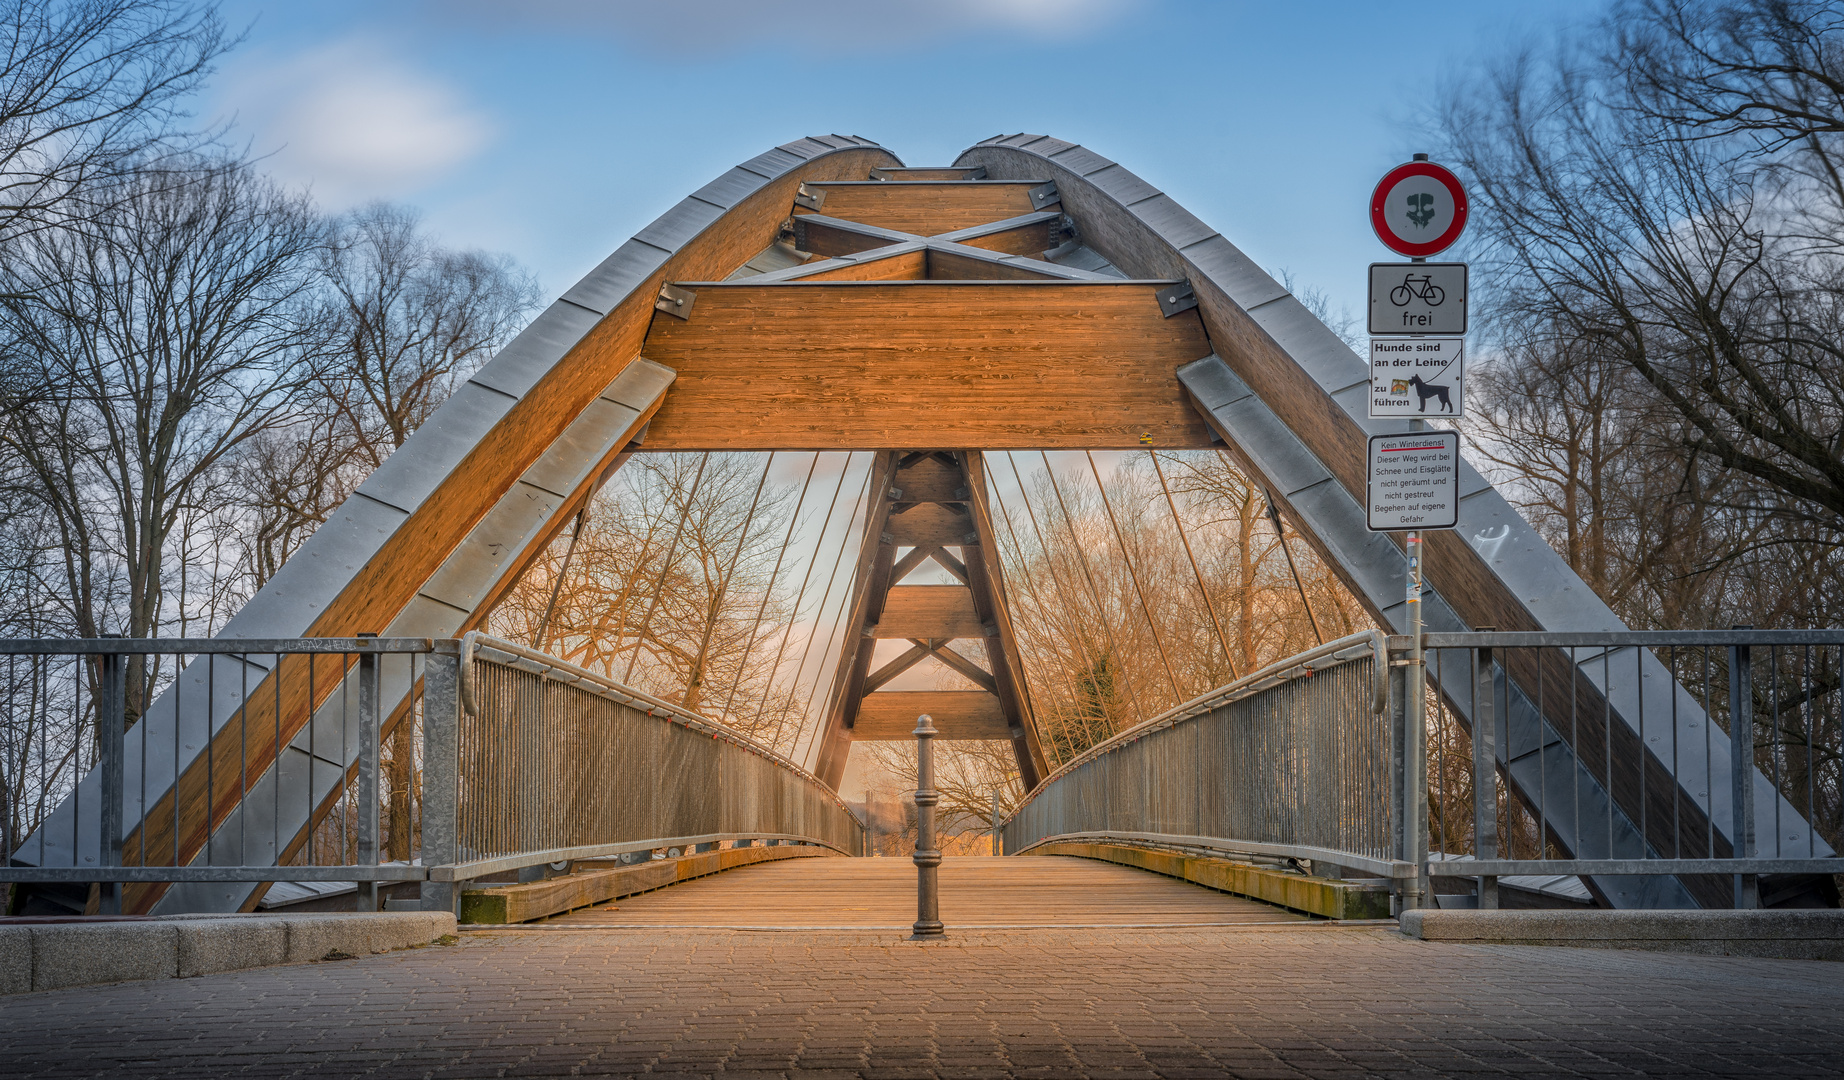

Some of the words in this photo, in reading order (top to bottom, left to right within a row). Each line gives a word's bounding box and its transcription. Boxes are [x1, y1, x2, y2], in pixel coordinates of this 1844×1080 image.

[1403, 311, 1432, 326] frei
[1374, 343, 1412, 352] Hunde
[1416, 343, 1440, 352] sind
[1374, 359, 1388, 367] an
[1392, 358, 1412, 367] der
[1415, 358, 1448, 367] Leine
[1374, 398, 1410, 407] führen
[1381, 441, 1397, 449] Kein
[1399, 439, 1444, 448] Winterdienst
[1402, 455, 1418, 463] Weg
[1376, 468, 1402, 476] Schnee
[1420, 465, 1451, 474] Eisglätte
[1400, 479, 1430, 488] geräumt
[1404, 490, 1434, 500] gestreut
[1375, 504, 1406, 514] Begehen
[1422, 502, 1446, 512] eigene
